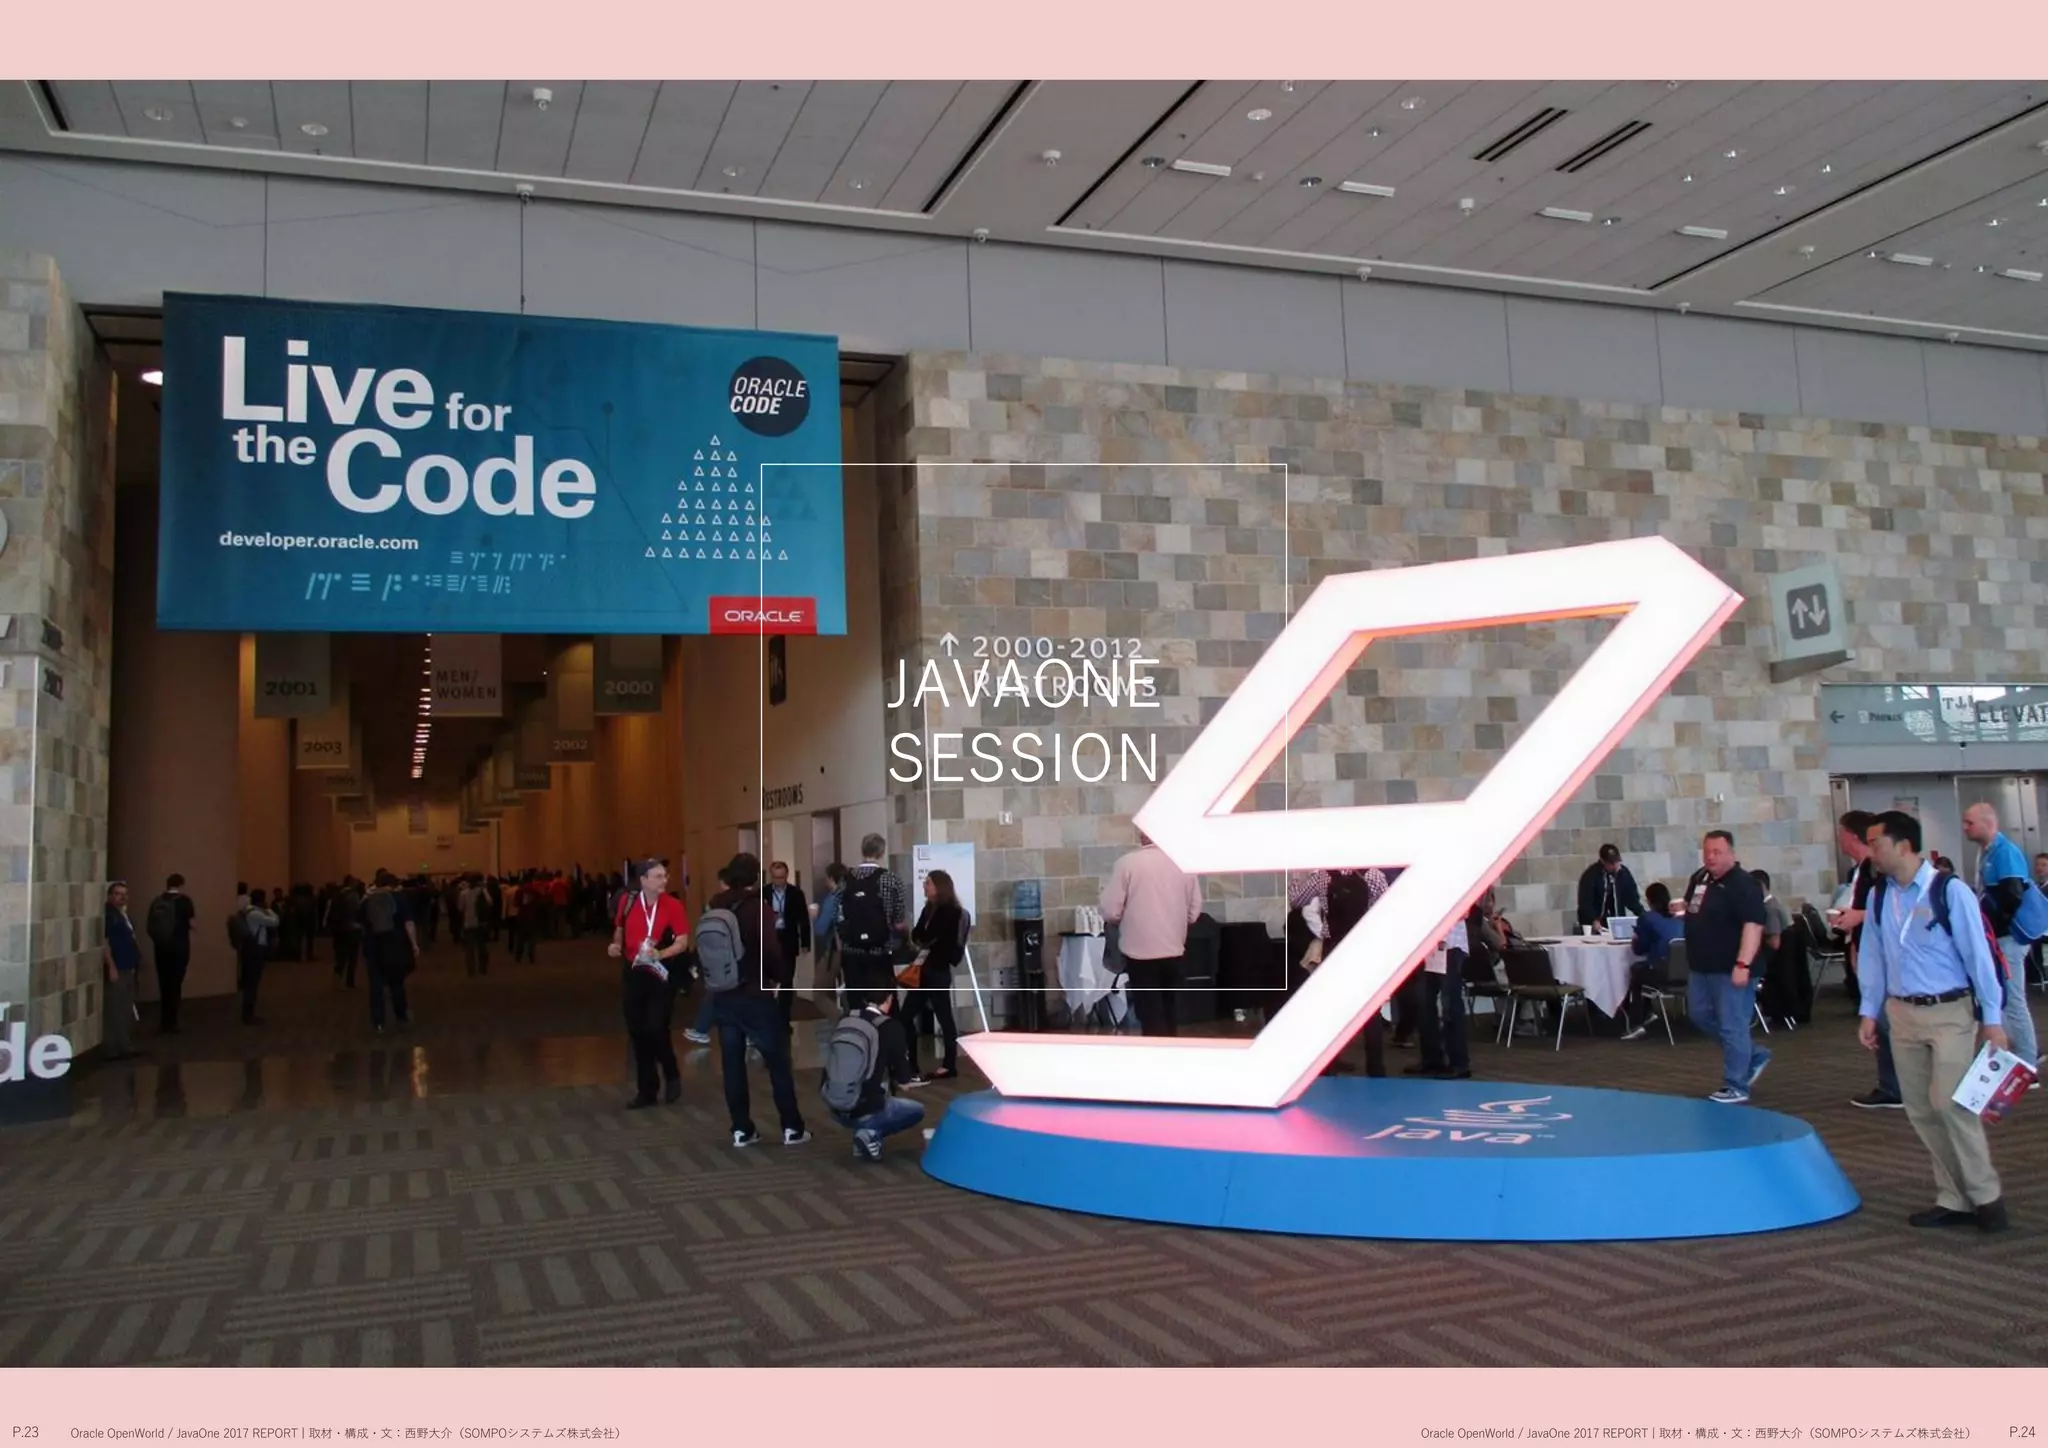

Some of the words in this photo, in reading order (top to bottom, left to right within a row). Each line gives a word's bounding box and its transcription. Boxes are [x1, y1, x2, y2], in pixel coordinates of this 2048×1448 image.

[223, 336, 434, 430] Live
[445, 392, 512, 432] for
[734, 377, 808, 398] ORACLE
[730, 396, 783, 415] CODE
[233, 425, 317, 465] the
[327, 428, 597, 519] Code
[219, 531, 419, 550] developer.oracle.com
[724, 610, 802, 622] ORACLE
[972, 636, 1143, 659] 2000-2012
[436, 670, 480, 683] MEN/
[265, 680, 318, 697] 2001
[436, 686, 497, 700] WOMEN
[605, 680, 654, 695] 2000
[303, 740, 343, 755] 2003
